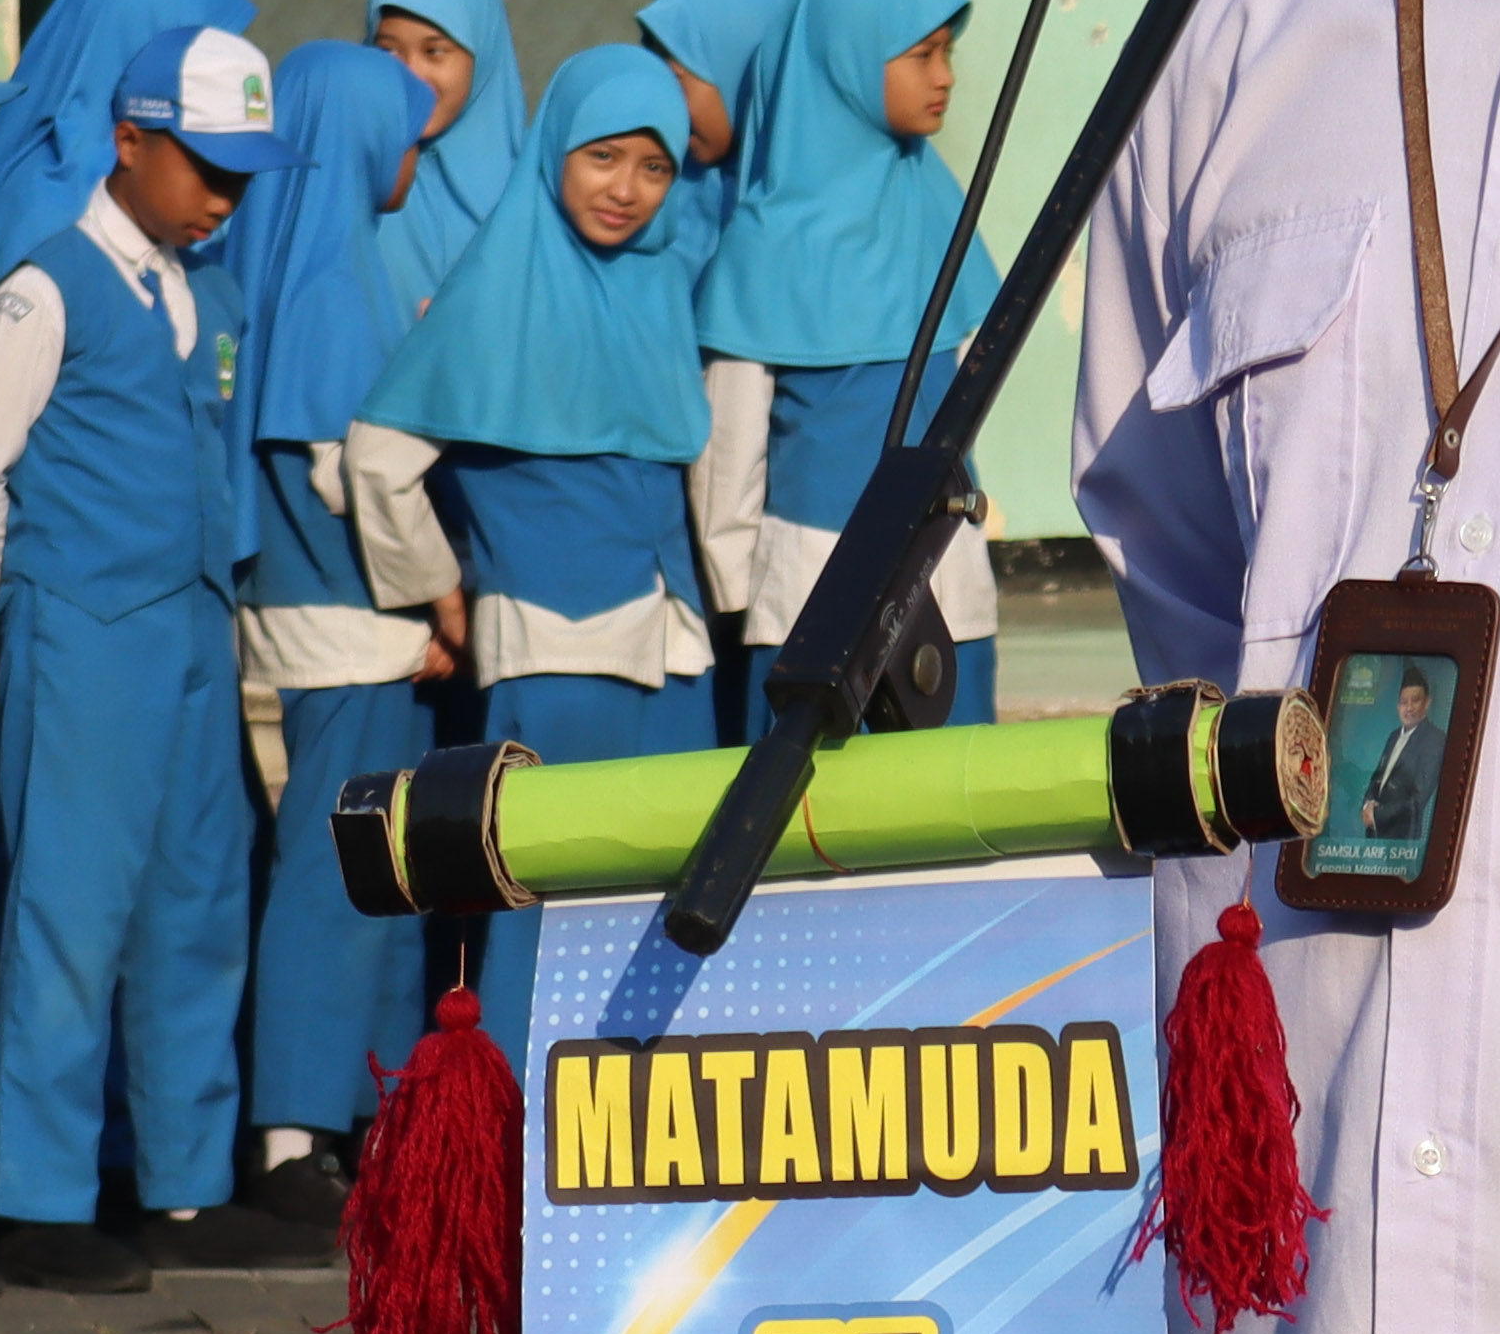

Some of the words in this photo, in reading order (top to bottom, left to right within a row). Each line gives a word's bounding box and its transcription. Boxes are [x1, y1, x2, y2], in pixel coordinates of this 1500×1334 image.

[1317, 843, 1360, 858] SAMSUL
[1363, 846, 1388, 862] ARIF,
[553, 1036, 1130, 1192] MATAMUDA
